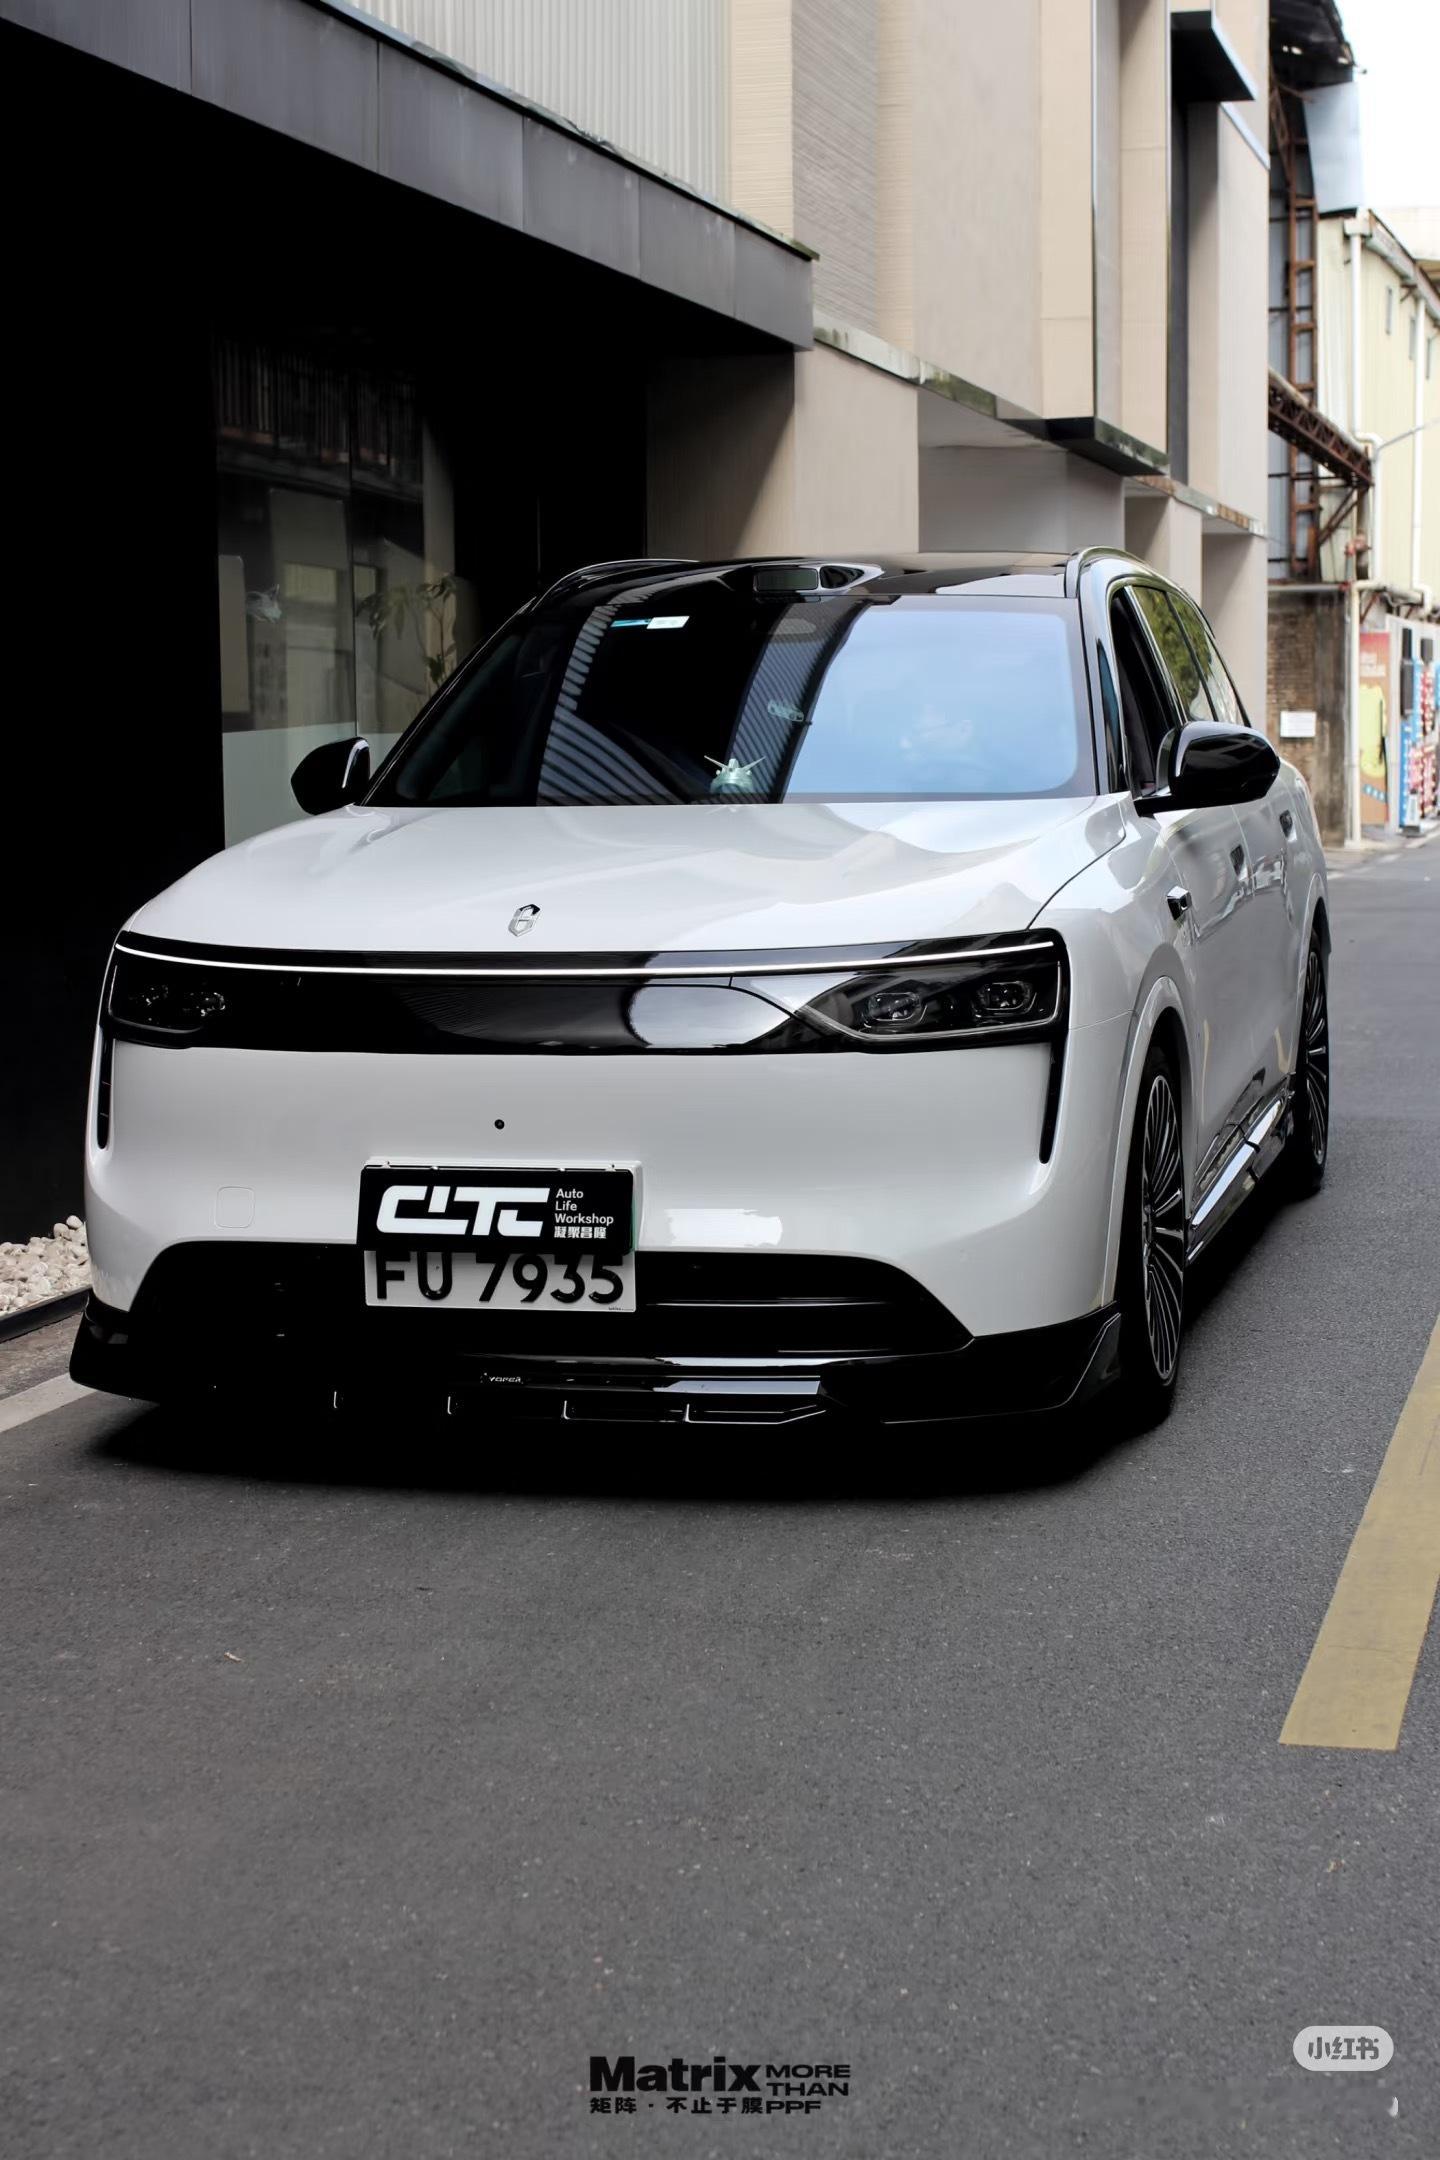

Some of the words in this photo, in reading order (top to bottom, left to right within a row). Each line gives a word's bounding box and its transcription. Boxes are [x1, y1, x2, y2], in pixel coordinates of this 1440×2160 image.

[555, 1188, 584, 1199] Auto
[555, 1200, 578, 1211] Life
[554, 1212, 614, 1226] Workshop
[376, 1251, 452, 1300] FU
[475, 1253, 624, 1304] 7935
